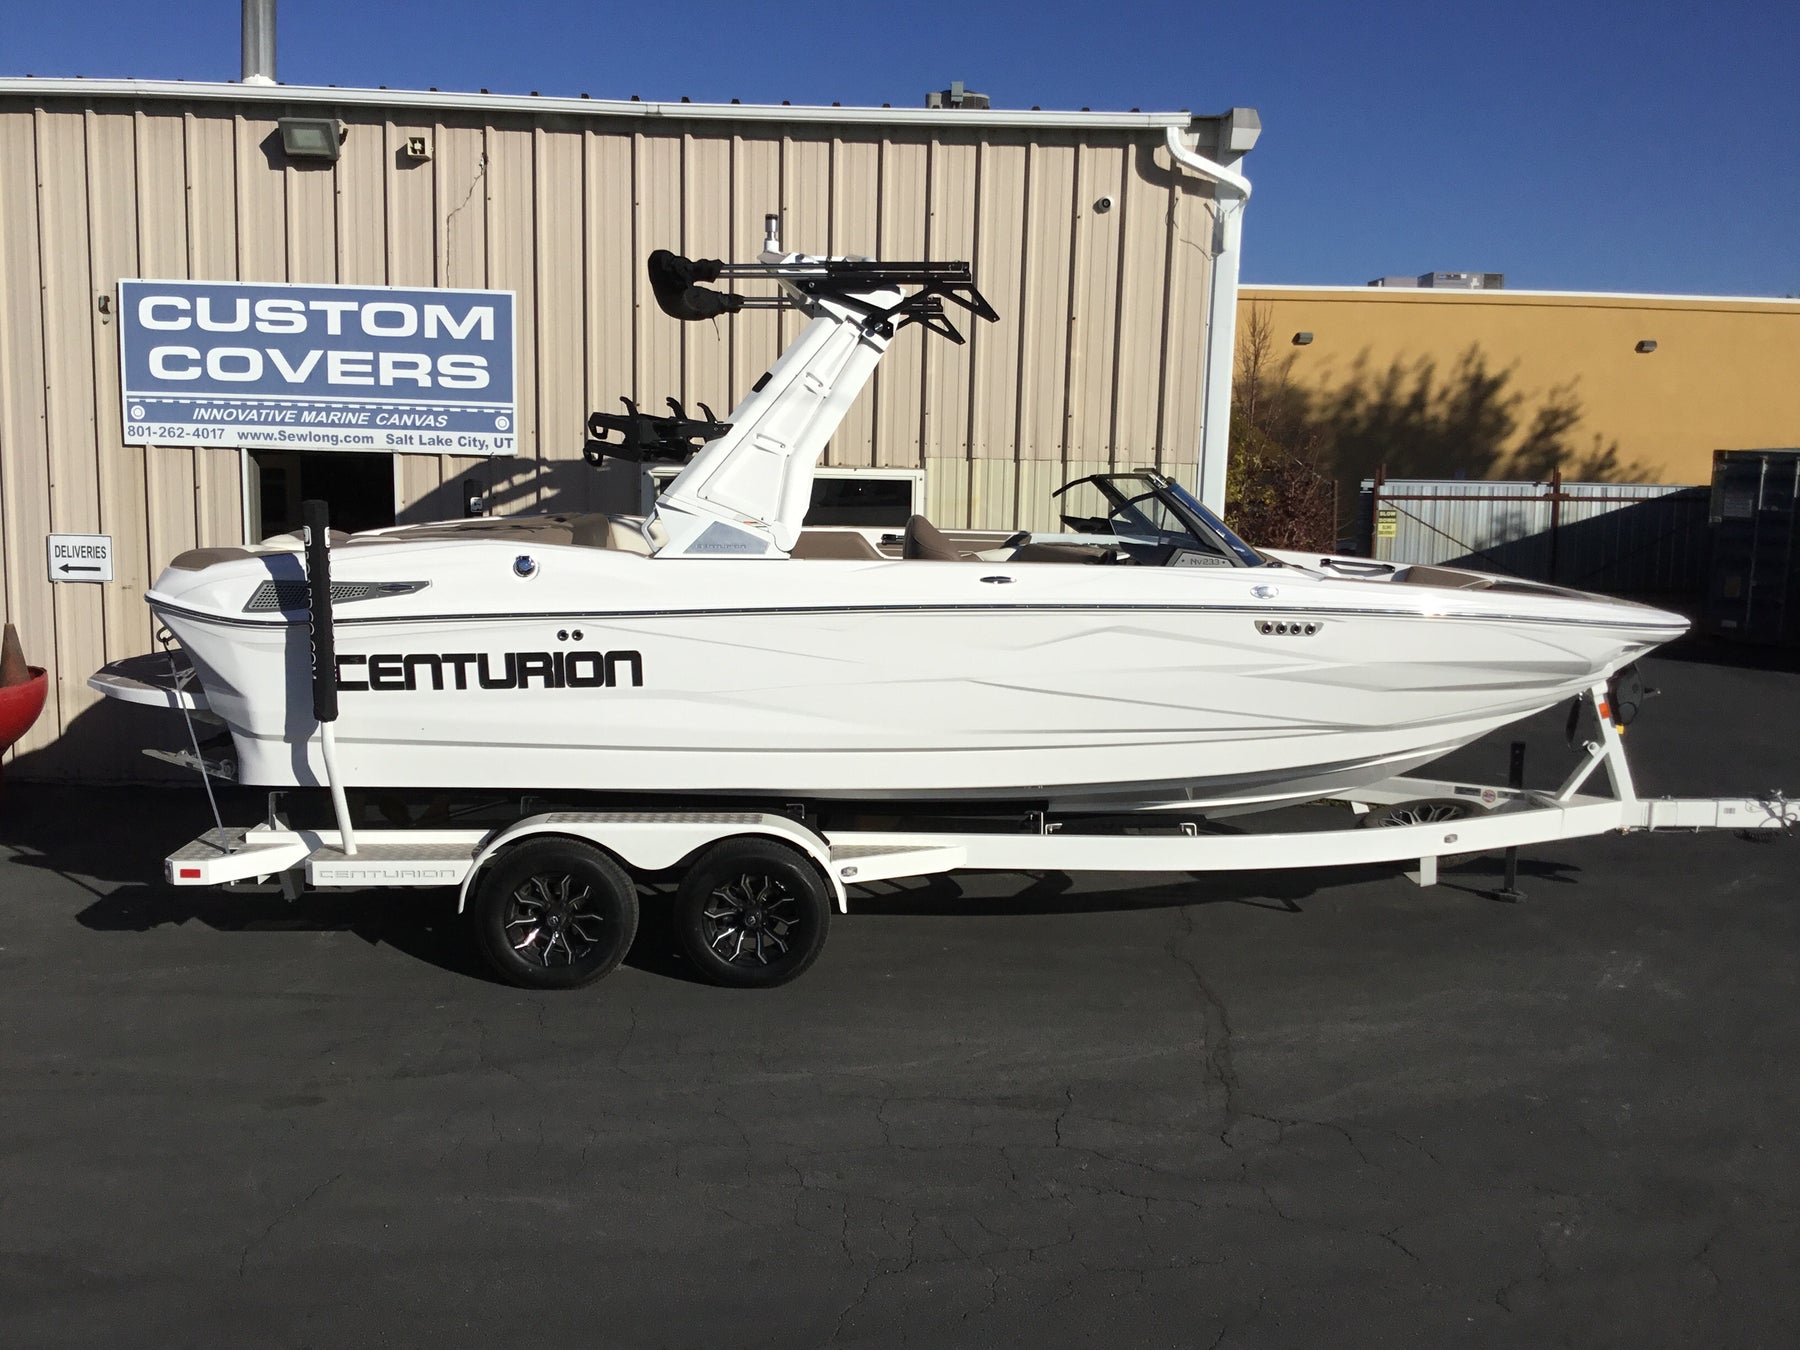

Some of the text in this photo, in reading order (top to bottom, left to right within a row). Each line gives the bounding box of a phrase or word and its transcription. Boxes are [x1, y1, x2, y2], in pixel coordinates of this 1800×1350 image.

[137, 296, 495, 341] CUSTOM
[148, 346, 490, 389] COVERS
[192, 407, 448, 428] INNOVATIVE MARINE CANVAS
[127, 425, 514, 450] 801-262-4017 www.Sewlong.com Salt Lake City, UT
[54, 545, 107, 559] DELIVERIES
[335, 650, 644, 691] CENTURION
[319, 869, 456, 879] CENTURION
